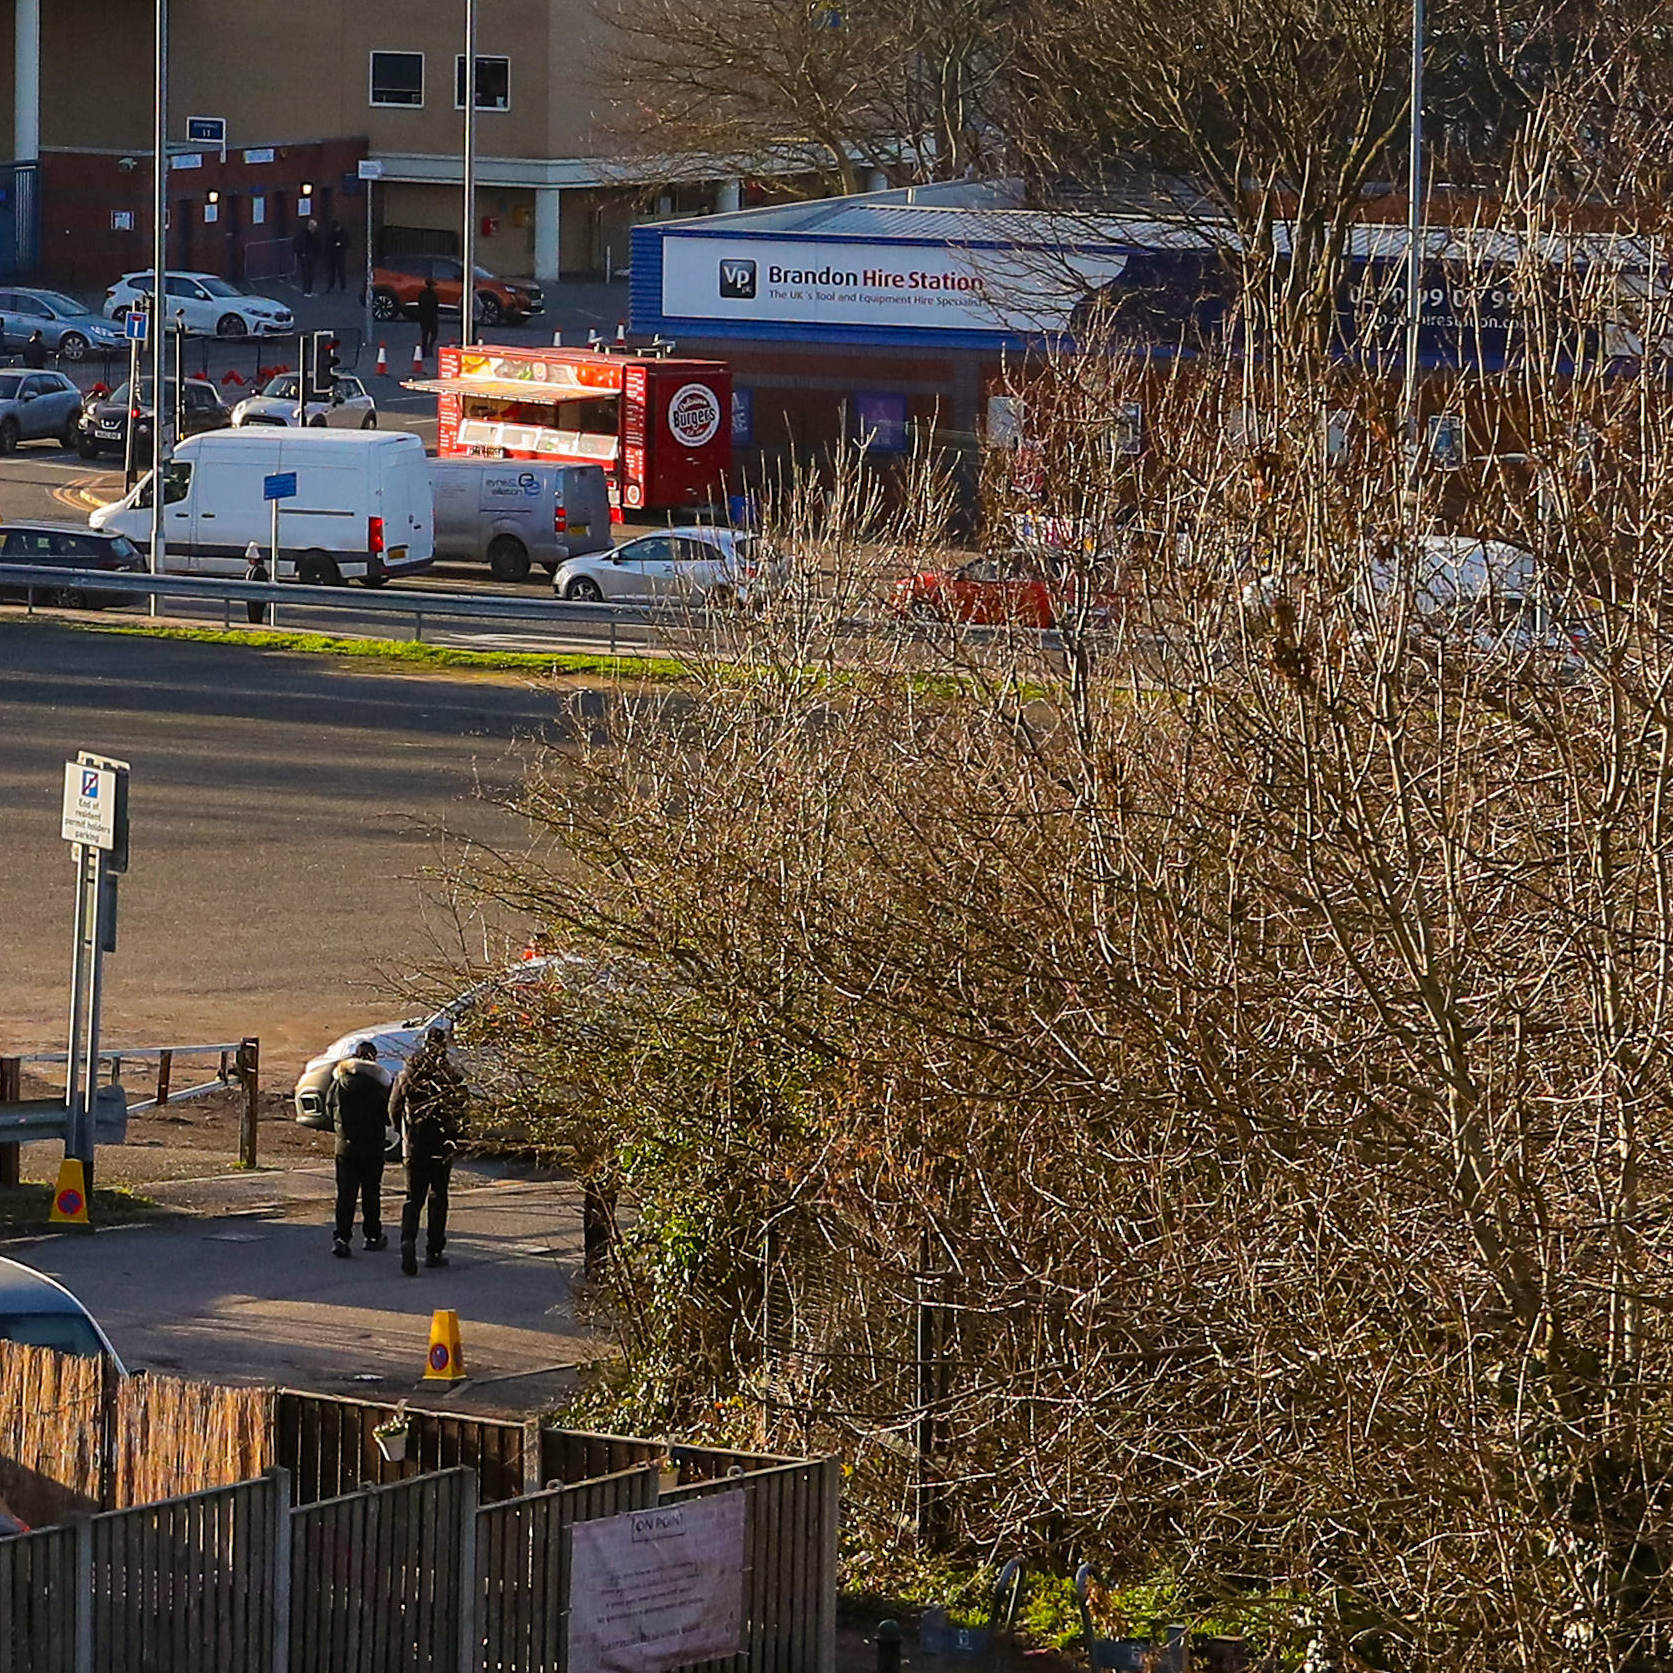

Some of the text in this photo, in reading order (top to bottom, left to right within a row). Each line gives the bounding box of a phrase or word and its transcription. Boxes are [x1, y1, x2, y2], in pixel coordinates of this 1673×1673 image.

[723, 266, 751, 289] Vp
[769, 265, 984, 291] Brandon Hire Station
[770, 290, 788, 300] The
[816, 291, 836, 302] Tool
[838, 293, 856, 303] and
[859, 294, 912, 306] Equipment
[914, 296, 934, 305] Hire
[673, 408, 717, 428] Burgers
